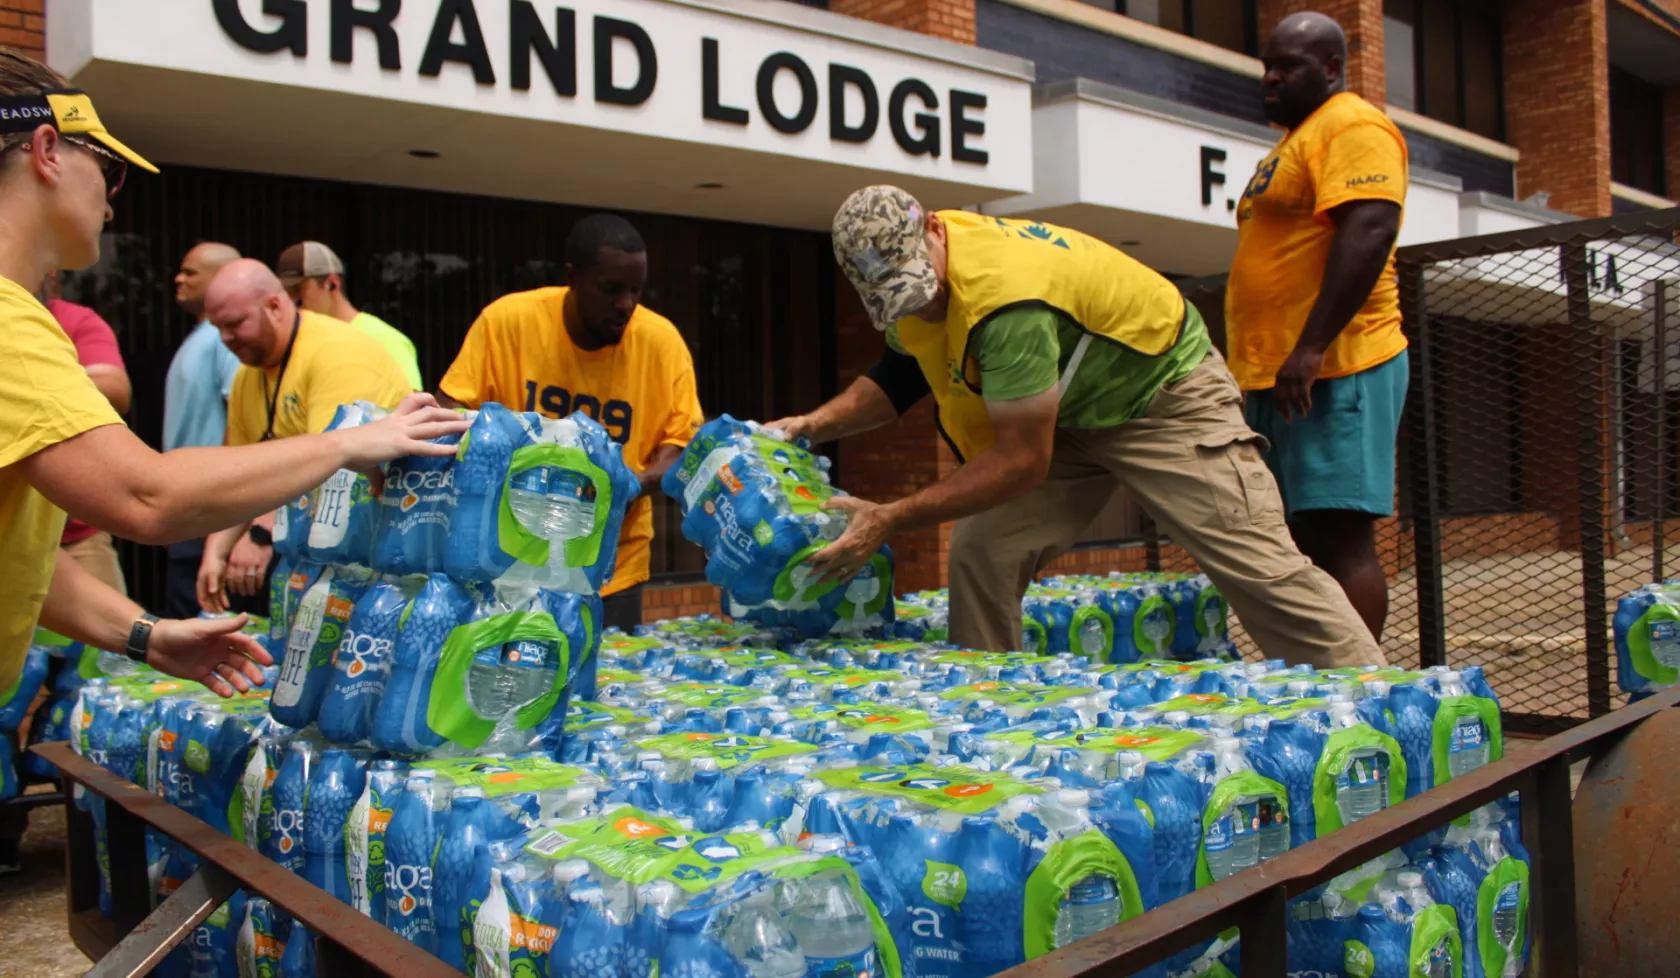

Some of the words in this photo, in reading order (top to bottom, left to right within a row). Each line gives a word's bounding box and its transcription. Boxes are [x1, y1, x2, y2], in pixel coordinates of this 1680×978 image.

[212, 0, 658, 106] GRAND
[701, 36, 990, 165] LODGE
[525, 379, 633, 445] 1909
[932, 870, 961, 889] 24
[927, 947, 961, 962] WATER
